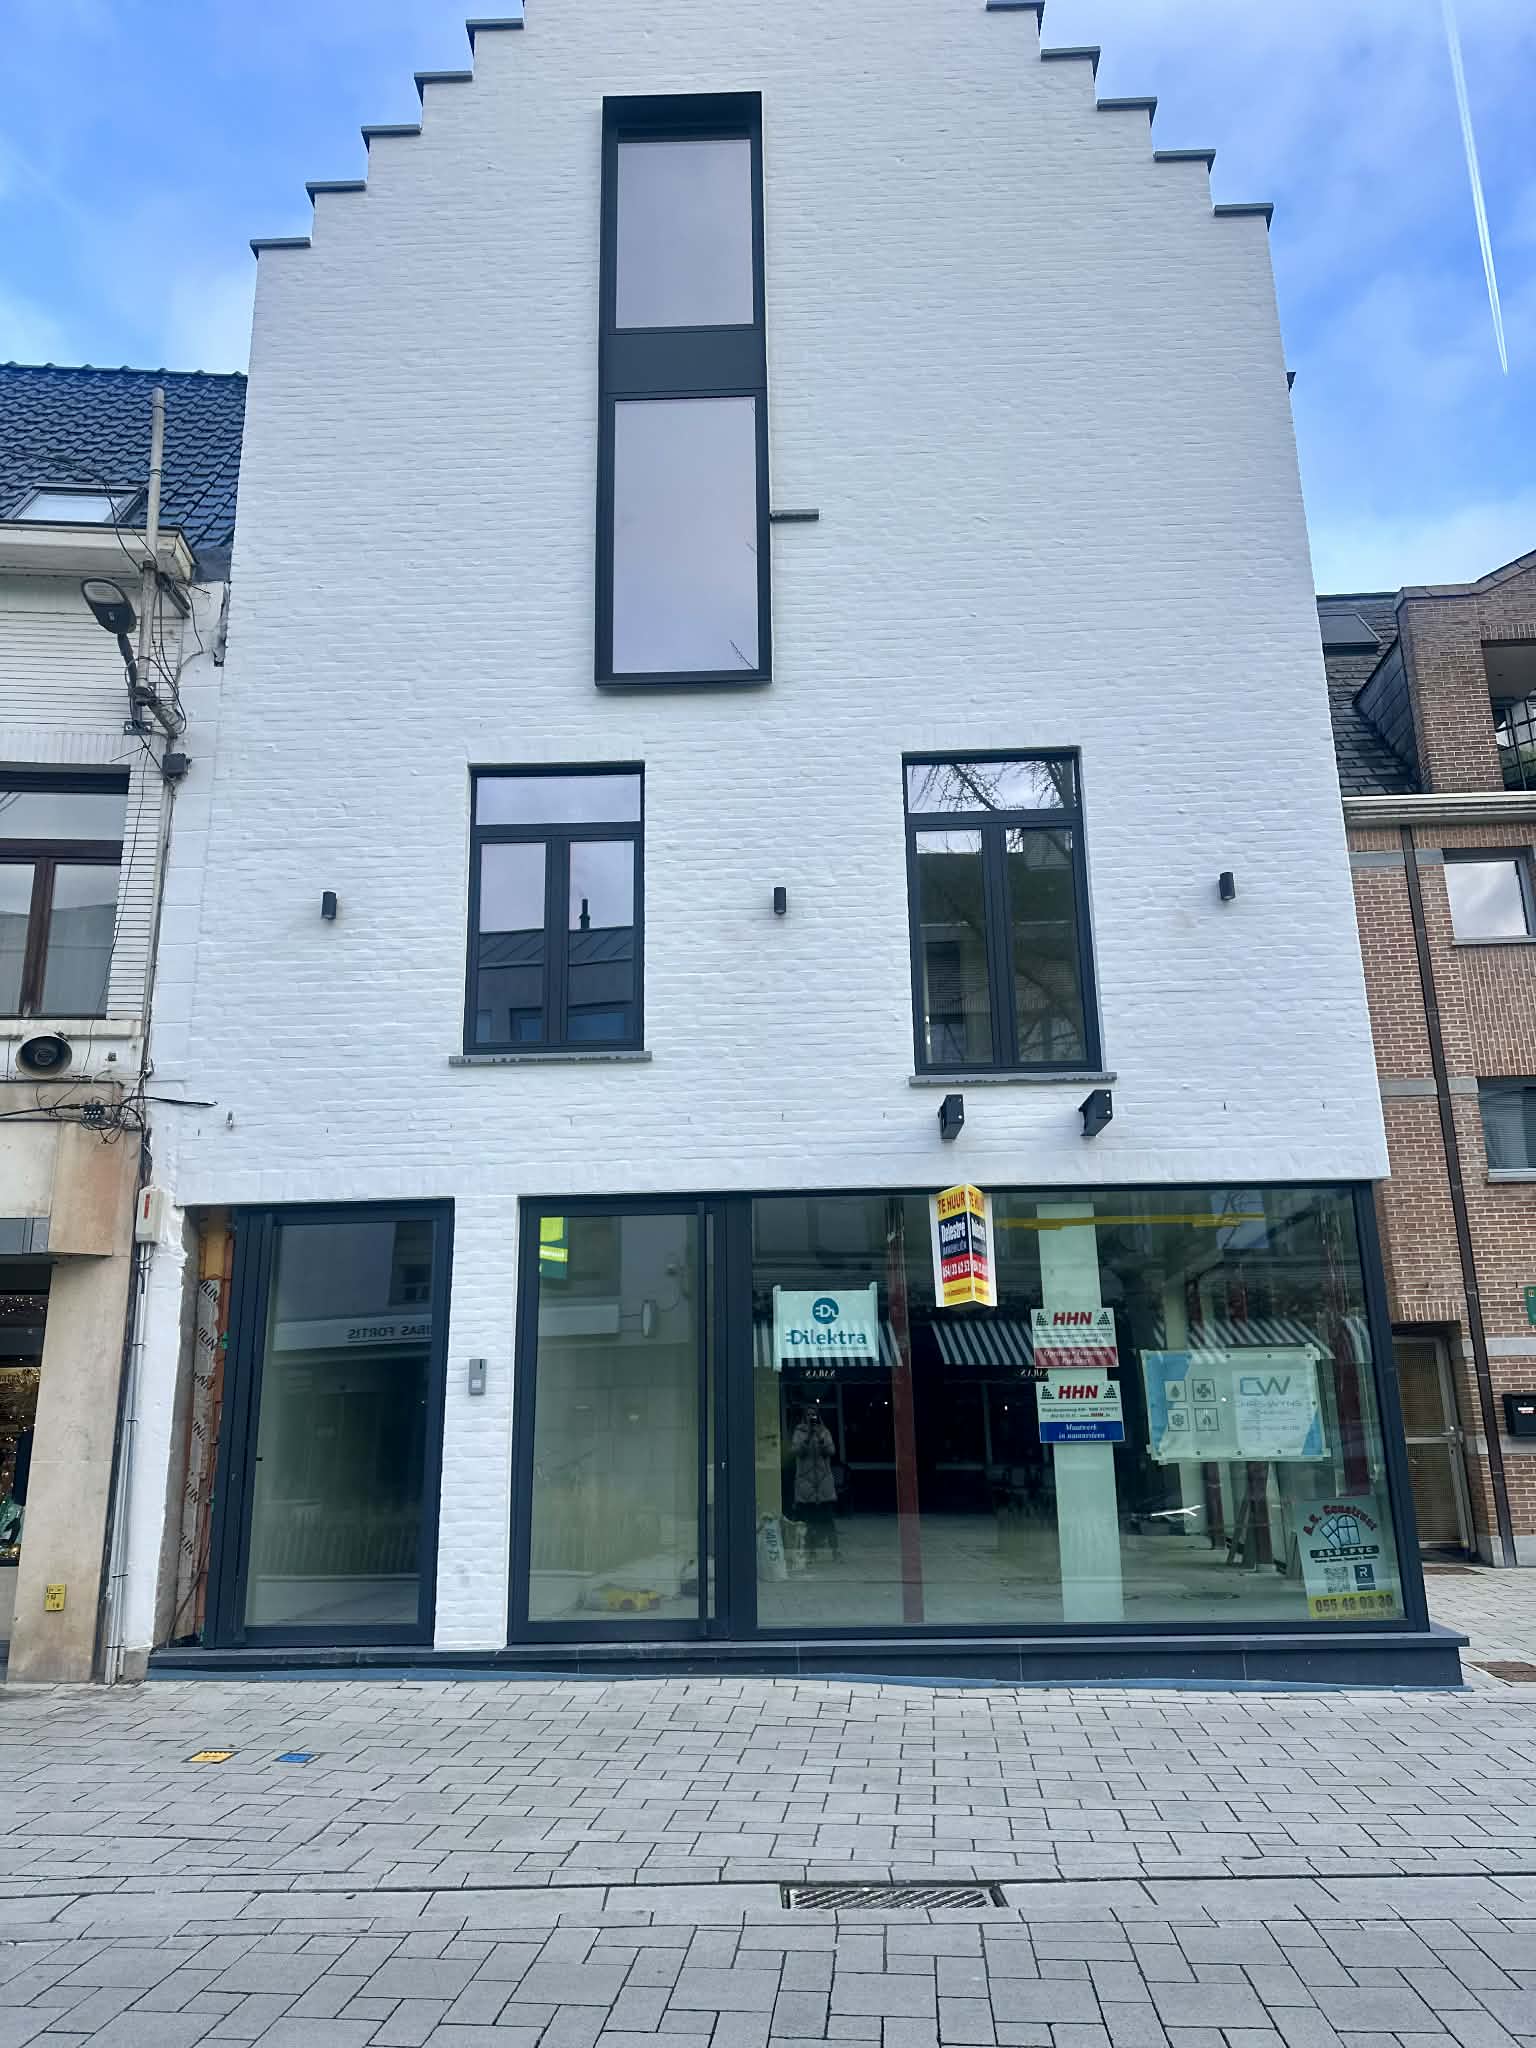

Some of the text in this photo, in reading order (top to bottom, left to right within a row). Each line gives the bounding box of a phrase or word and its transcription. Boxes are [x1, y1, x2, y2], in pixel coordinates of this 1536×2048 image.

[946, 1191, 966, 1211] HUUR
[1053, 1311, 1093, 1326] HHN
[786, 1328, 867, 1345] Dilektra
[1058, 1385, 1098, 1399] HHN
[1240, 1376, 1291, 1396] CW
